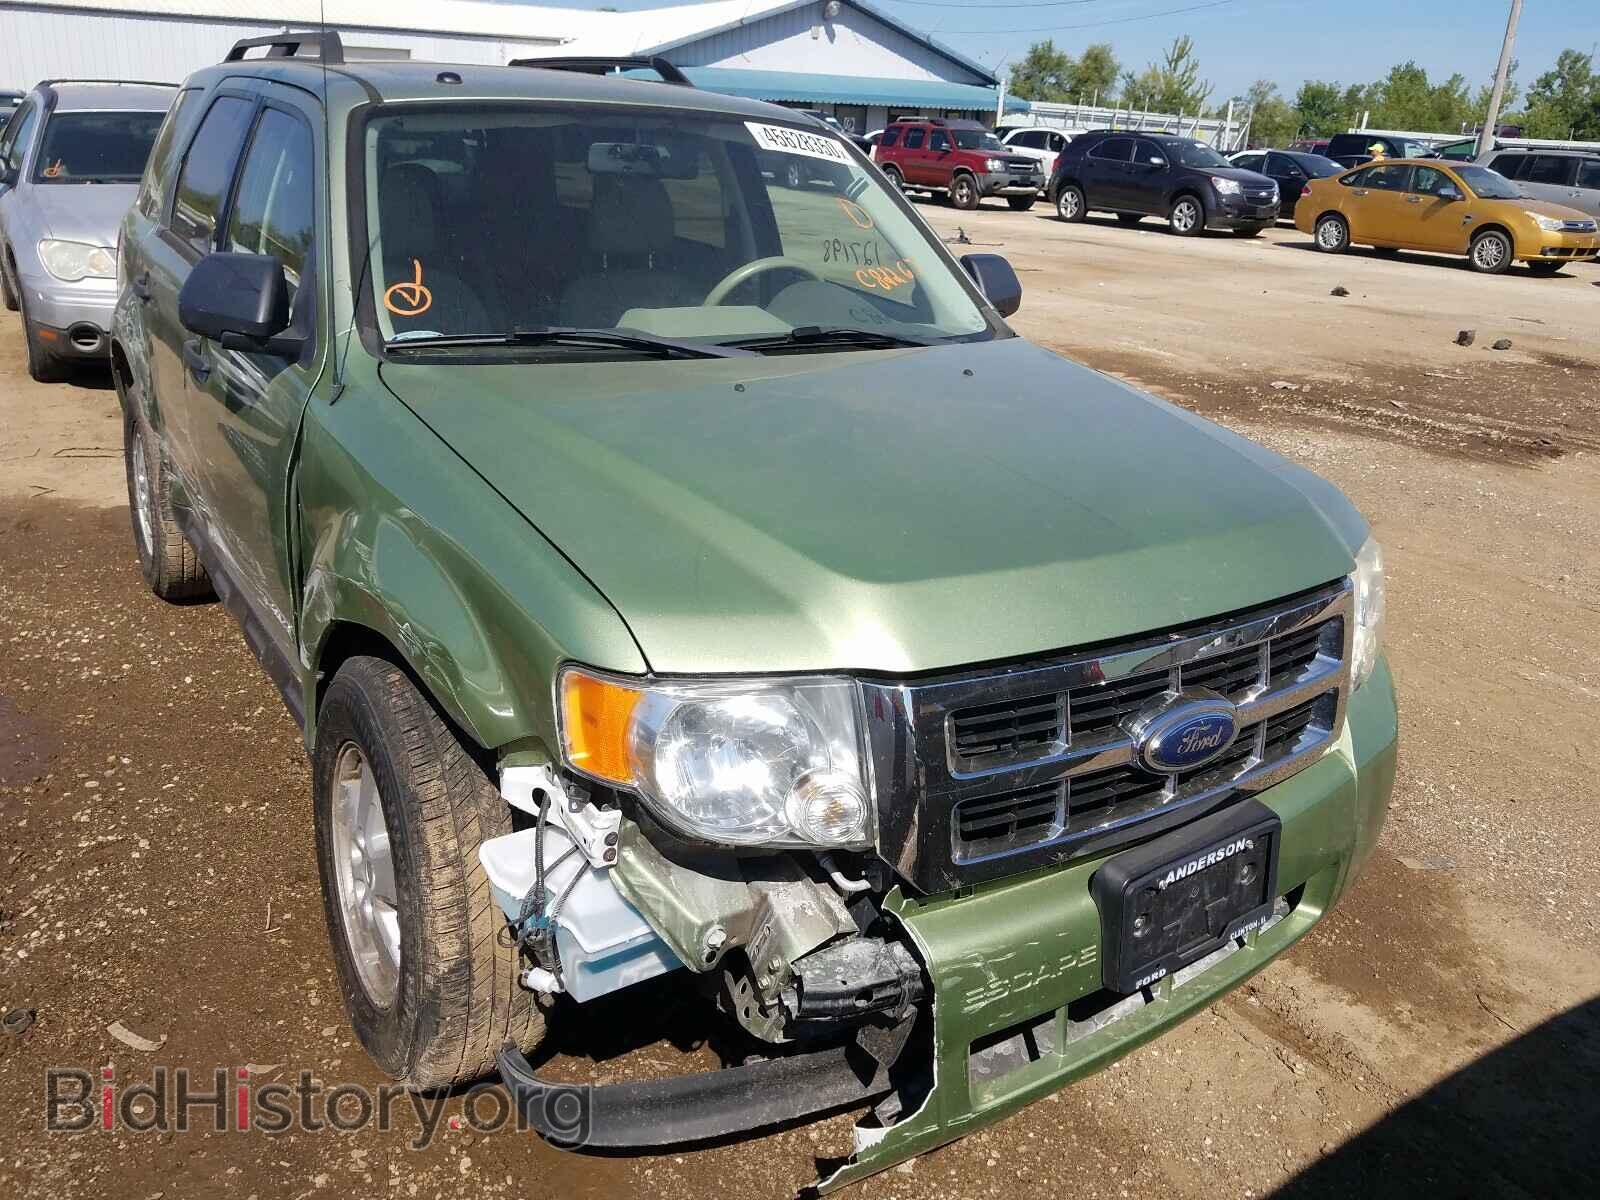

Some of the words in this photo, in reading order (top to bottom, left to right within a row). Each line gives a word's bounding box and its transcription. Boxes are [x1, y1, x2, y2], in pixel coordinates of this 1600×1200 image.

[762, 127, 842, 159] 45628350
[1176, 724, 1224, 754] Ford
[1165, 837, 1246, 885] ANDERSON
[961, 944, 1097, 1014] ESCAPE
[1135, 967, 1167, 989] FORD
